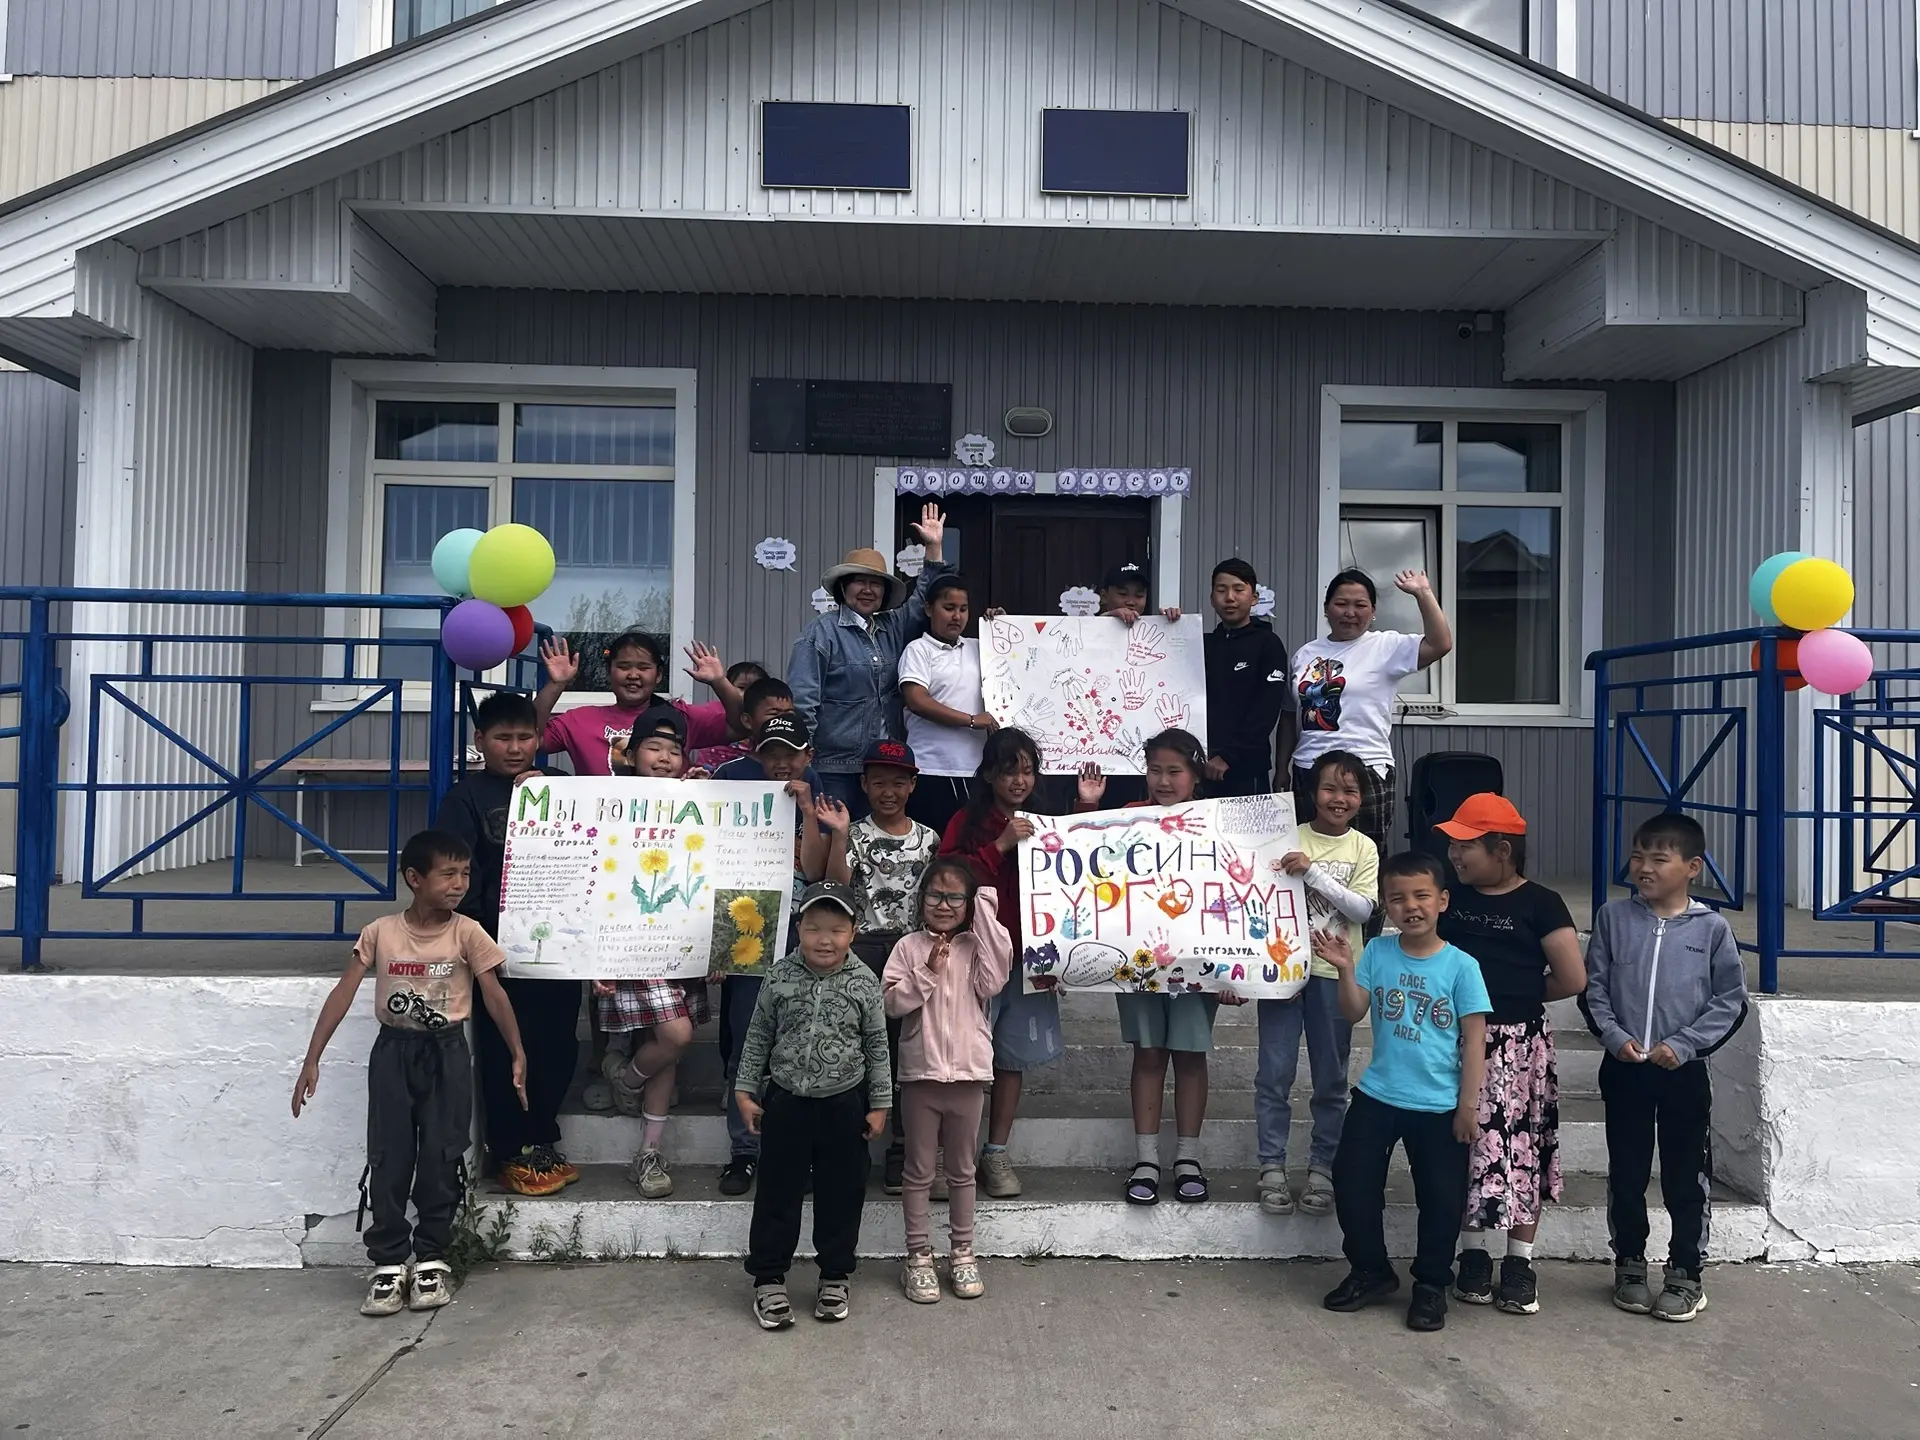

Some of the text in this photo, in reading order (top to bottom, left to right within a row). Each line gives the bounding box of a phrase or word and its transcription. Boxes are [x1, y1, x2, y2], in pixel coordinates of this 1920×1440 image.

[1062, 475, 1184, 487] ЛАГЕРЬ
[768, 718, 793, 727] Dior
[595, 792, 775, 828] ЮННАТЫ!
[634, 827, 677, 841] ГЕРБ
[1031, 841, 1217, 890] РОССИН
[387, 962, 454, 977] MOTOR RACE
[1399, 973, 1427, 990] RACE
[1374, 986, 1454, 1030] 1976
[1392, 1023, 1421, 1044] AREA
